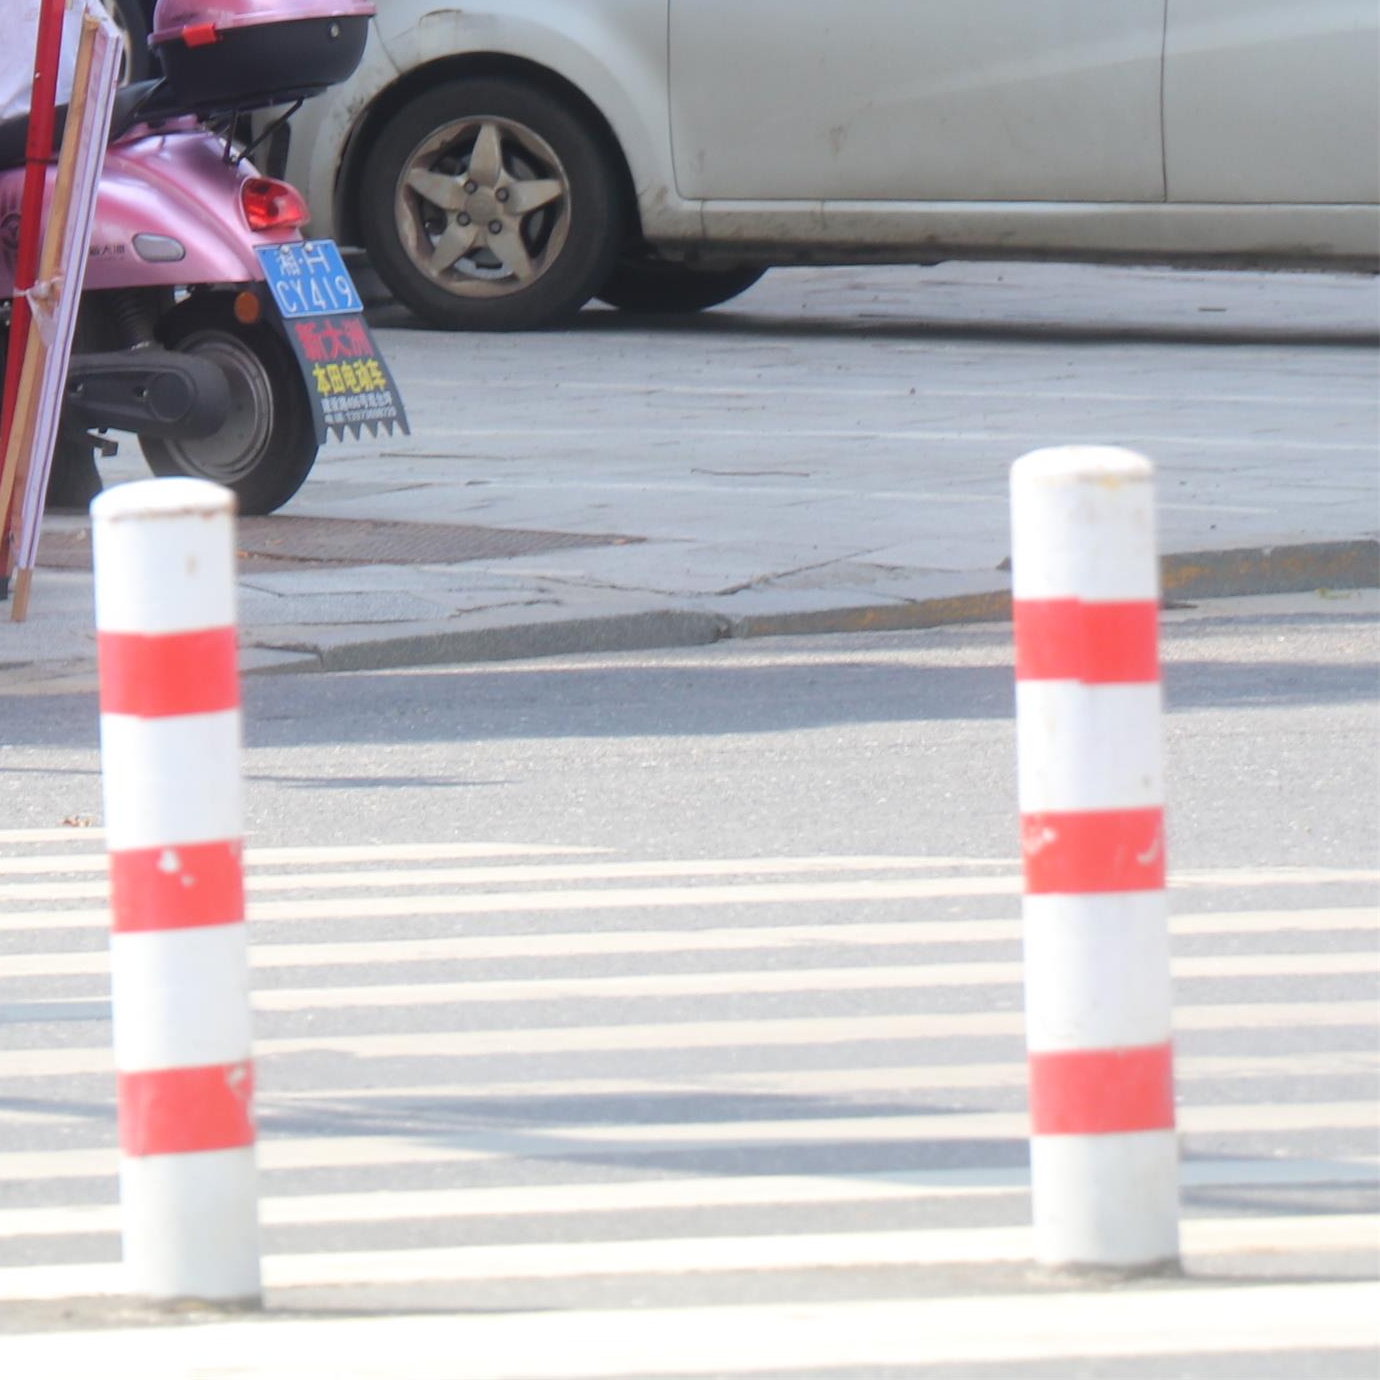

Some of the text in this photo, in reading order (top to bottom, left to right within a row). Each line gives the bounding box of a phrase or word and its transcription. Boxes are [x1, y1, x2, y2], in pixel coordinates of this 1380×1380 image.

[276, 275, 354, 314] CY419
[312, 357, 387, 396] 本田电动车
